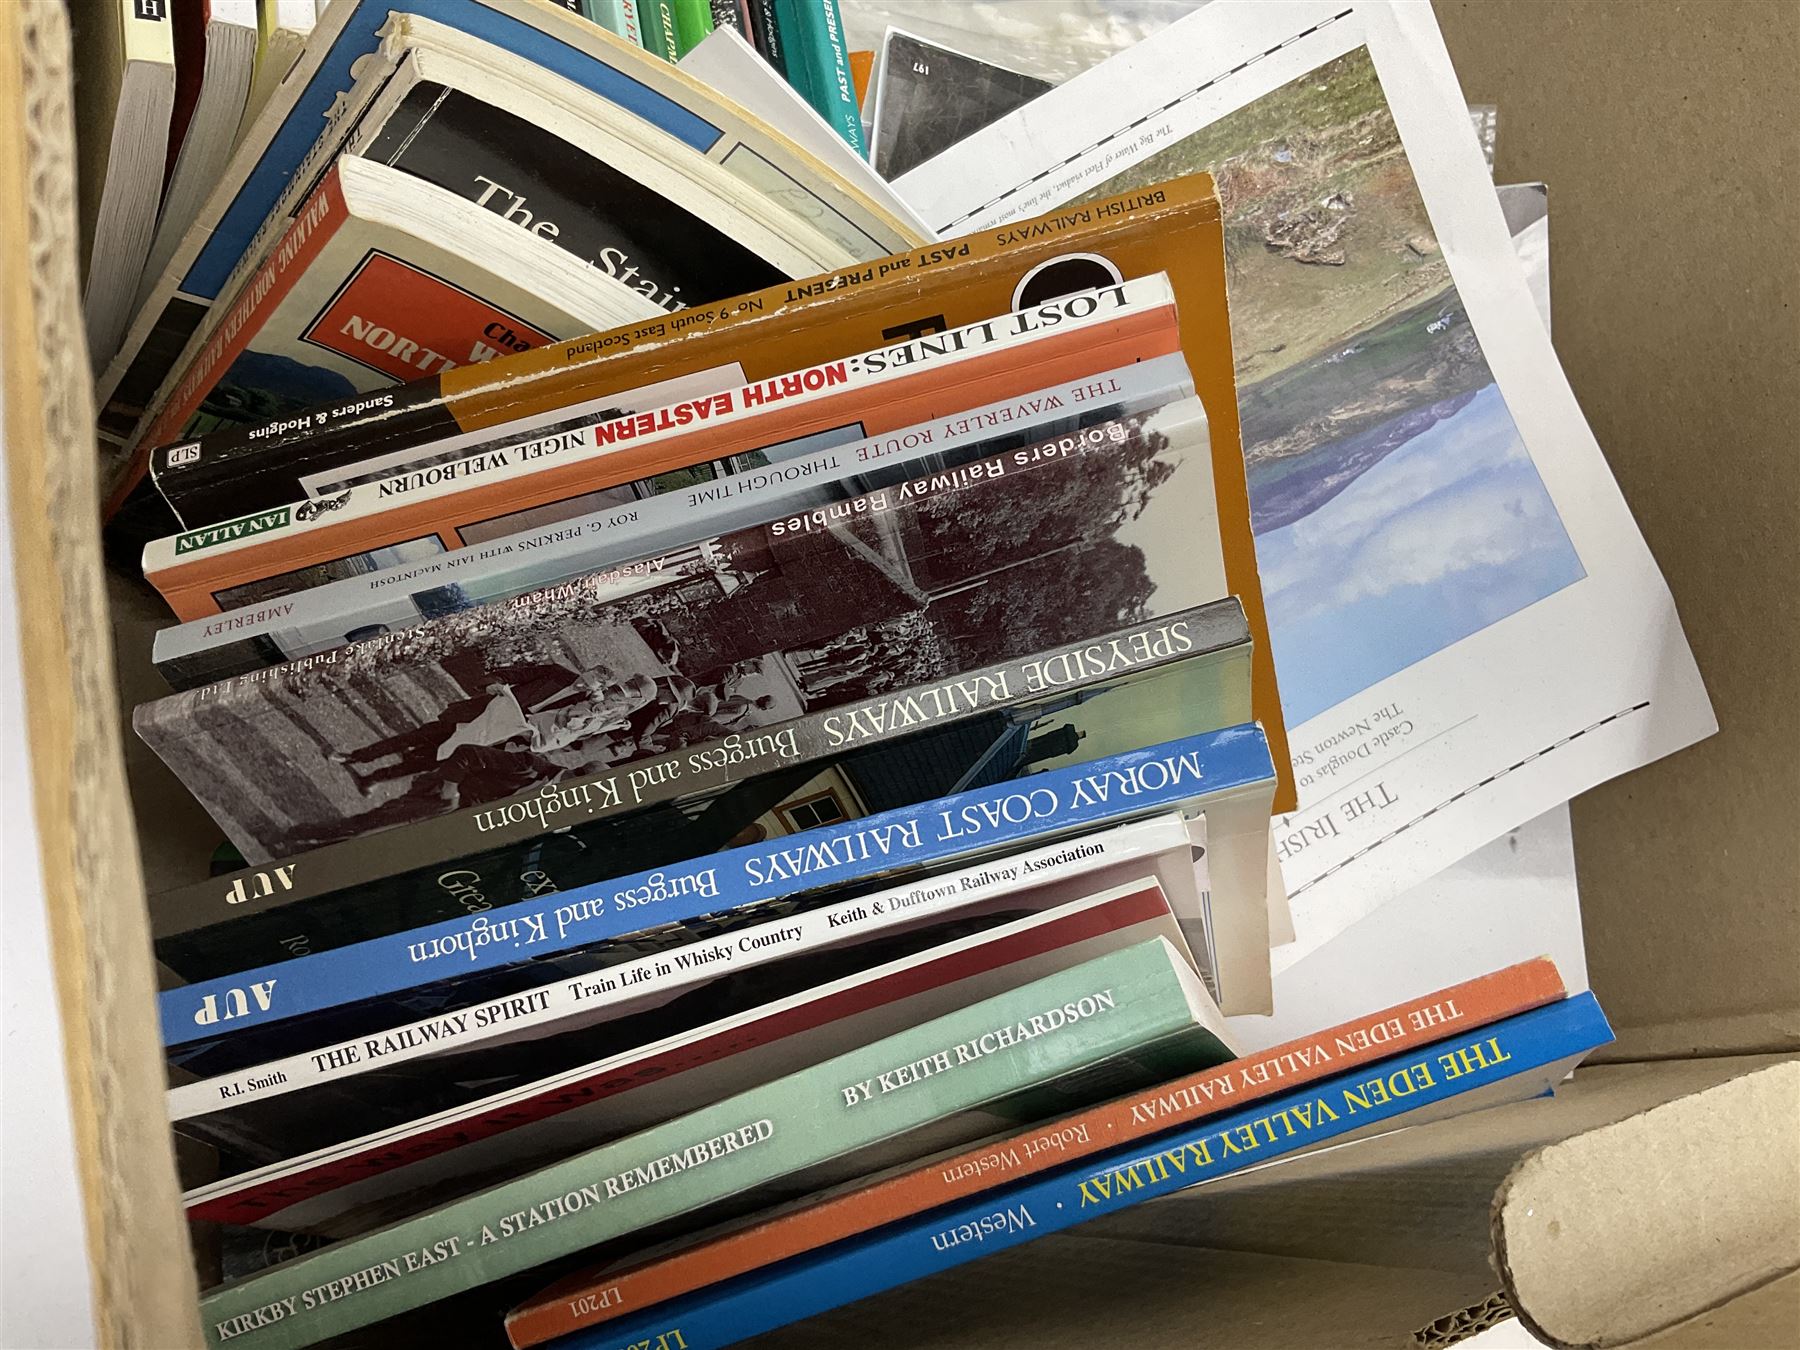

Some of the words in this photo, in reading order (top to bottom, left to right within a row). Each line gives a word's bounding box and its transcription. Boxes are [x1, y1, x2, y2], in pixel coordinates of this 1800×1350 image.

[824, 0, 839, 42] PRESE
[832, 44, 844, 65] and
[836, 67, 850, 102] PAST
[1139, 135, 1154, 147] Big
[1156, 124, 1173, 139] The
[1115, 143, 1138, 159] Water
[1086, 160, 1103, 178] Fleet
[474, 175, 560, 243] The
[1040, 189, 1052, 201] the
[1097, 190, 1166, 220] BRITISH
[279, 191, 330, 273] WALKING
[997, 213, 1091, 246] RAILWAYS
[998, 209, 1016, 222] most
[879, 257, 911, 279] and
[917, 242, 970, 267] PAST
[784, 268, 874, 304] PRESENT
[224, 269, 276, 347] NORTHERN
[671, 310, 714, 330] South
[719, 307, 730, 320] 9
[1010, 286, 1131, 335] LOST
[566, 332, 631, 360] Scotland
[640, 324, 666, 340] East
[851, 323, 994, 375] LINES:
[742, 362, 848, 408] NORTH
[1072, 378, 1122, 403] THE
[315, 411, 328, 424] &
[332, 394, 394, 420] Sanders
[595, 392, 732, 447] EASTERN
[944, 395, 1064, 436] WAVERLEY
[248, 416, 311, 441] Hodgins
[514, 431, 585, 461] NIGEL
[856, 424, 933, 462] ROUTE
[1014, 423, 1128, 466] Borders
[171, 445, 198, 463] SLP
[378, 453, 509, 499] WELBOURN
[738, 456, 840, 493] THROUGH
[899, 459, 1004, 501] Railway
[688, 485, 734, 508] TIME
[249, 511, 287, 532] IAN
[587, 520, 602, 534] G.
[608, 511, 638, 529] ROY
[772, 493, 888, 537] Rambles
[179, 522, 246, 551] ALLAN
[479, 543, 514, 561] WITH
[519, 526, 582, 551] PERKINS
[447, 552, 475, 570] IAIN
[586, 556, 666, 588] Alasdair
[514, 583, 577, 608] Wham
[203, 601, 294, 639] AMBERLEY
[345, 626, 426, 657] Stenlake
[1021, 622, 1194, 692] SPEYSIDE
[240, 648, 337, 686] Publishing
[197, 679, 231, 700] Ltd.
[824, 672, 1014, 747] RAILWAYS
[1374, 703, 1403, 722] The
[1316, 719, 1370, 754] Newton
[1373, 720, 1413, 747] Castle
[689, 733, 801, 774] Burgess
[1317, 742, 1370, 776] Douglas
[628, 761, 681, 795] and
[1070, 750, 1204, 810] MORAY
[1300, 777, 1314, 788] to
[474, 777, 623, 832] Kinghorn
[938, 788, 1058, 841] COAST
[1340, 781, 1398, 822] THE
[745, 820, 922, 886] RAILWAYS
[225, 864, 297, 904] AUP
[614, 869, 720, 911] Burgess
[554, 899, 604, 930] and
[408, 916, 548, 963] Kinghorn
[220, 1082, 245, 1099] R.I.
[247, 1071, 288, 1093] Smith
[312, 1045, 361, 1073] THE
[366, 1012, 467, 1060] RAILWAY
[475, 990, 550, 1029] SPIRIT
[569, 978, 616, 1002] Train
[620, 965, 652, 988] Life
[655, 962, 672, 978] in
[675, 944, 734, 974] Whisky
[738, 924, 804, 953] Country
[827, 905, 868, 929] Keith
[872, 902, 885, 915] &
[888, 882, 958, 913] Dufftown
[960, 867, 1020, 895] Railway
[1022, 841, 1106, 876] Association
[195, 979, 277, 1026] AUP
[1414, 1000, 1463, 1030] THE
[841, 1082, 873, 1107] BY
[877, 1050, 953, 1093] KEITH
[956, 990, 1116, 1064] RICHARDSON
[1337, 1019, 1403, 1053] EDEN
[1240, 1042, 1328, 1089] VALLEY
[1445, 1038, 1511, 1080] THE
[1130, 1072, 1235, 1125] RAILWAY
[1349, 1063, 1436, 1115] EDEN
[1026, 1124, 1091, 1160] Robert
[1222, 1103, 1339, 1151] VALLEY
[942, 1147, 1021, 1184] Western
[1078, 1143, 1215, 1208] RAILWAY
[216, 1297, 298, 1342] KIRKBY
[300, 1259, 401, 1310] STEPHEN
[405, 1236, 461, 1270] EAST
[480, 1226, 497, 1246] A
[500, 1183, 600, 1237] STATION
[605, 1119, 773, 1198] REMEMBERED
[931, 1204, 1035, 1252] Western
[570, 1286, 623, 1317] LP201
